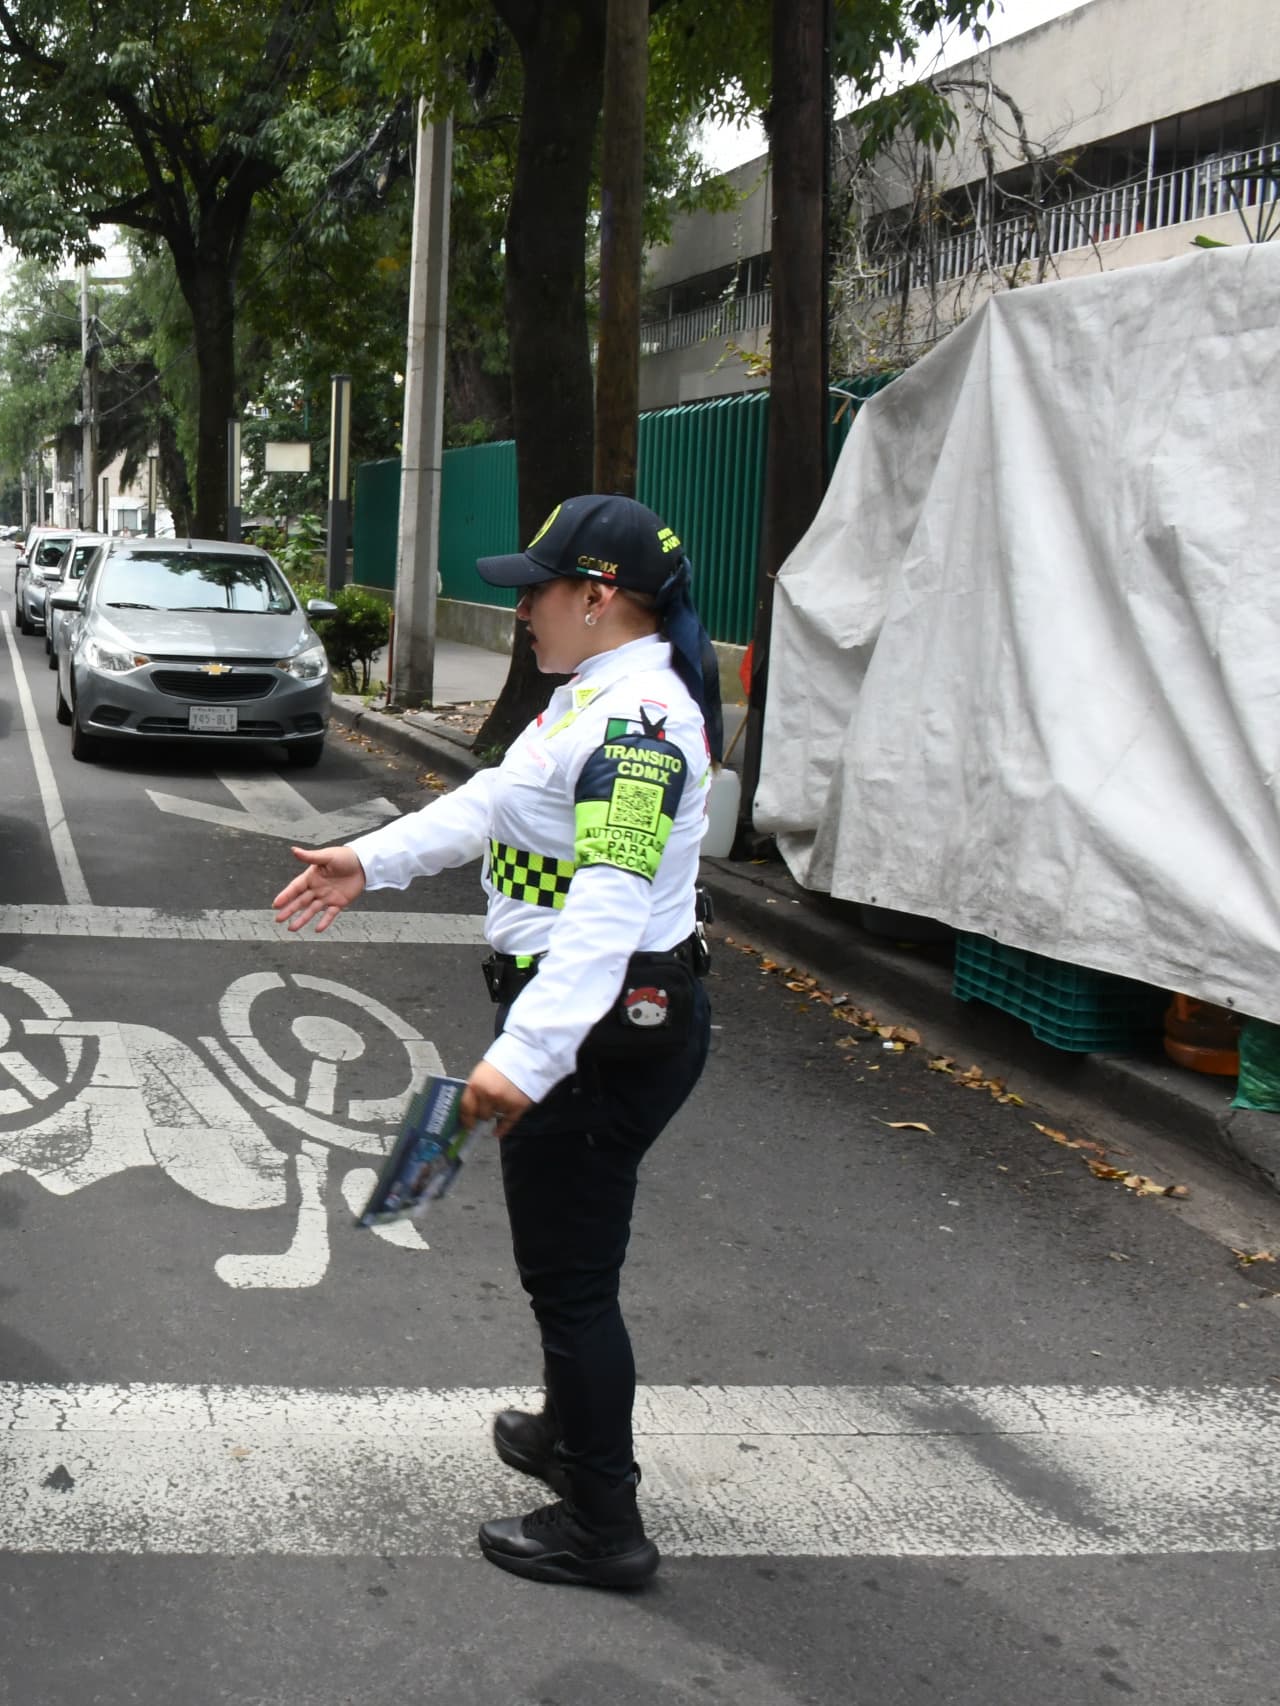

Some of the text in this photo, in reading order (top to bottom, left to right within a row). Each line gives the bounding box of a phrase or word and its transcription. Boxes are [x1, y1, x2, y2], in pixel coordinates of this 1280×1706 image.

[603, 744, 683, 774] TRANSITO
[617, 761, 672, 785] CDMX
[606, 840, 648, 859] PARA
